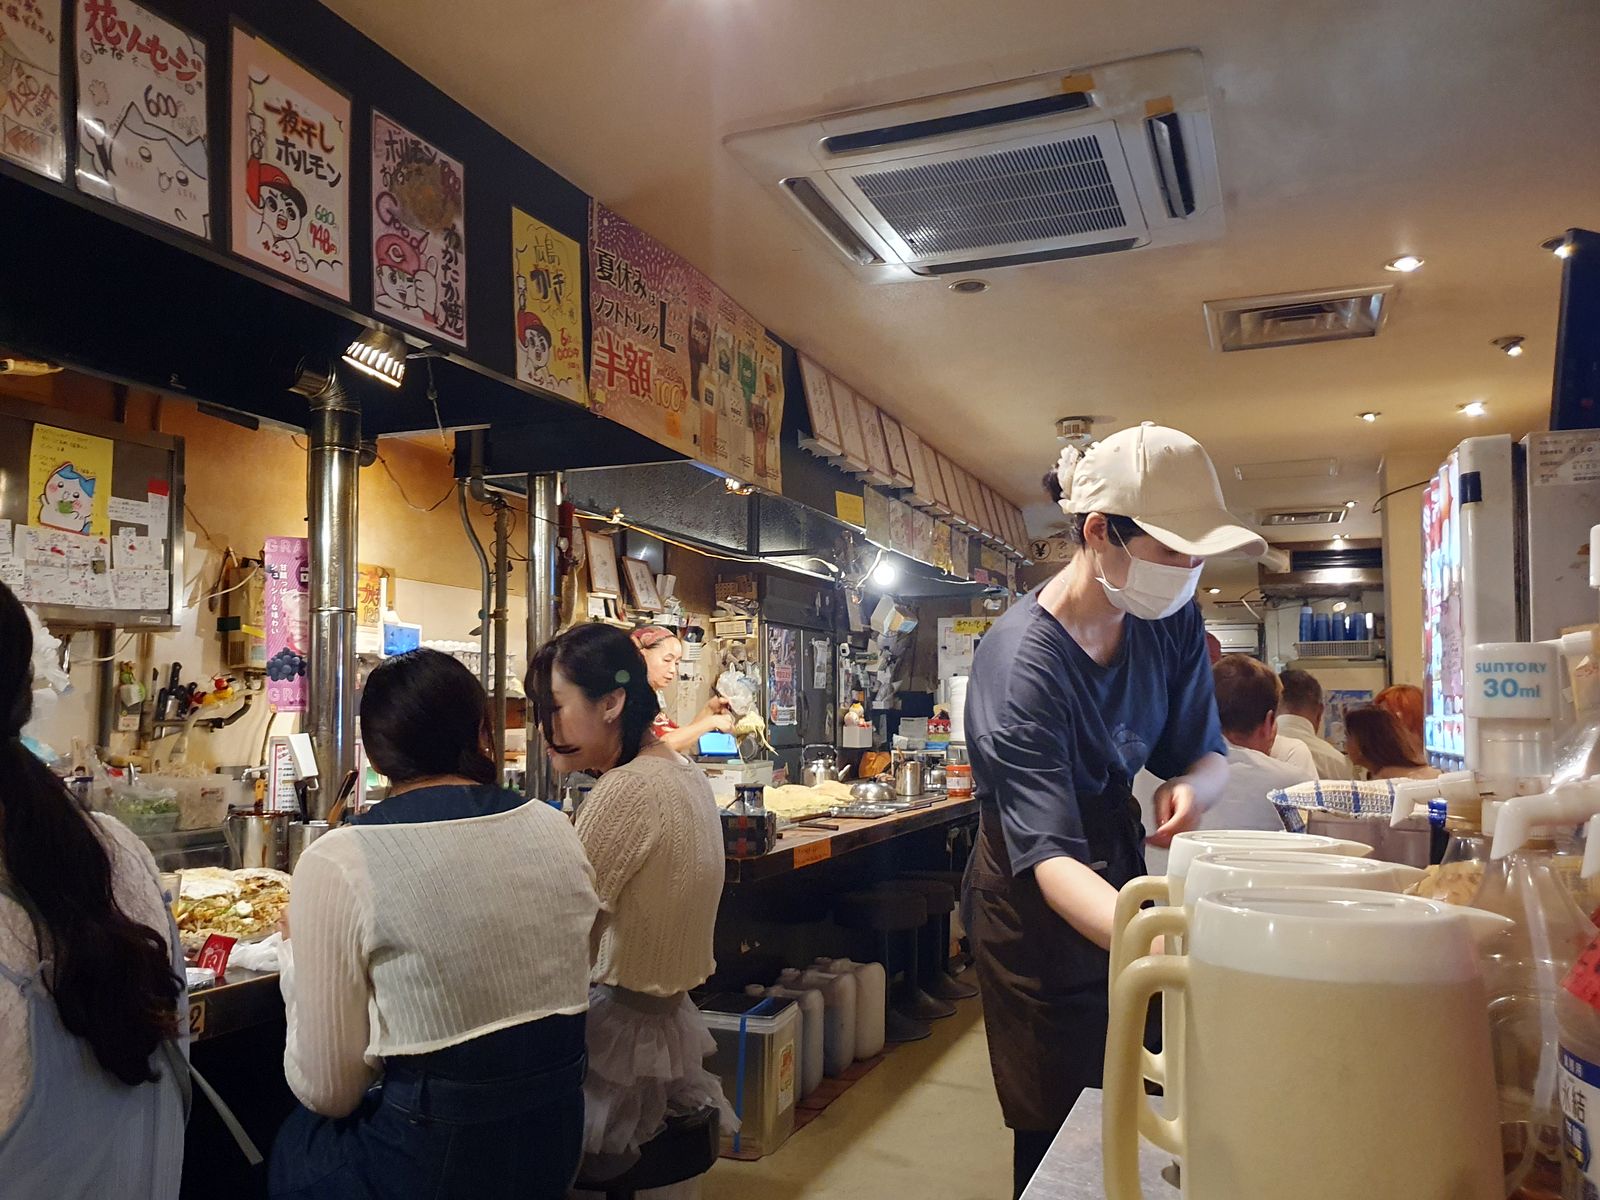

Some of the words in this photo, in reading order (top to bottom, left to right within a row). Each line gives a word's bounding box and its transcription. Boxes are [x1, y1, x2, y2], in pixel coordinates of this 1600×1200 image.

[264, 99, 334, 153] 一夜干し
[275, 136, 342, 188] ホルモン
[375, 191, 430, 250] Good
[594, 331, 654, 401] 半額
[1475, 662, 1547, 673] SUNTORY
[1483, 678, 1541, 698] 30ml
